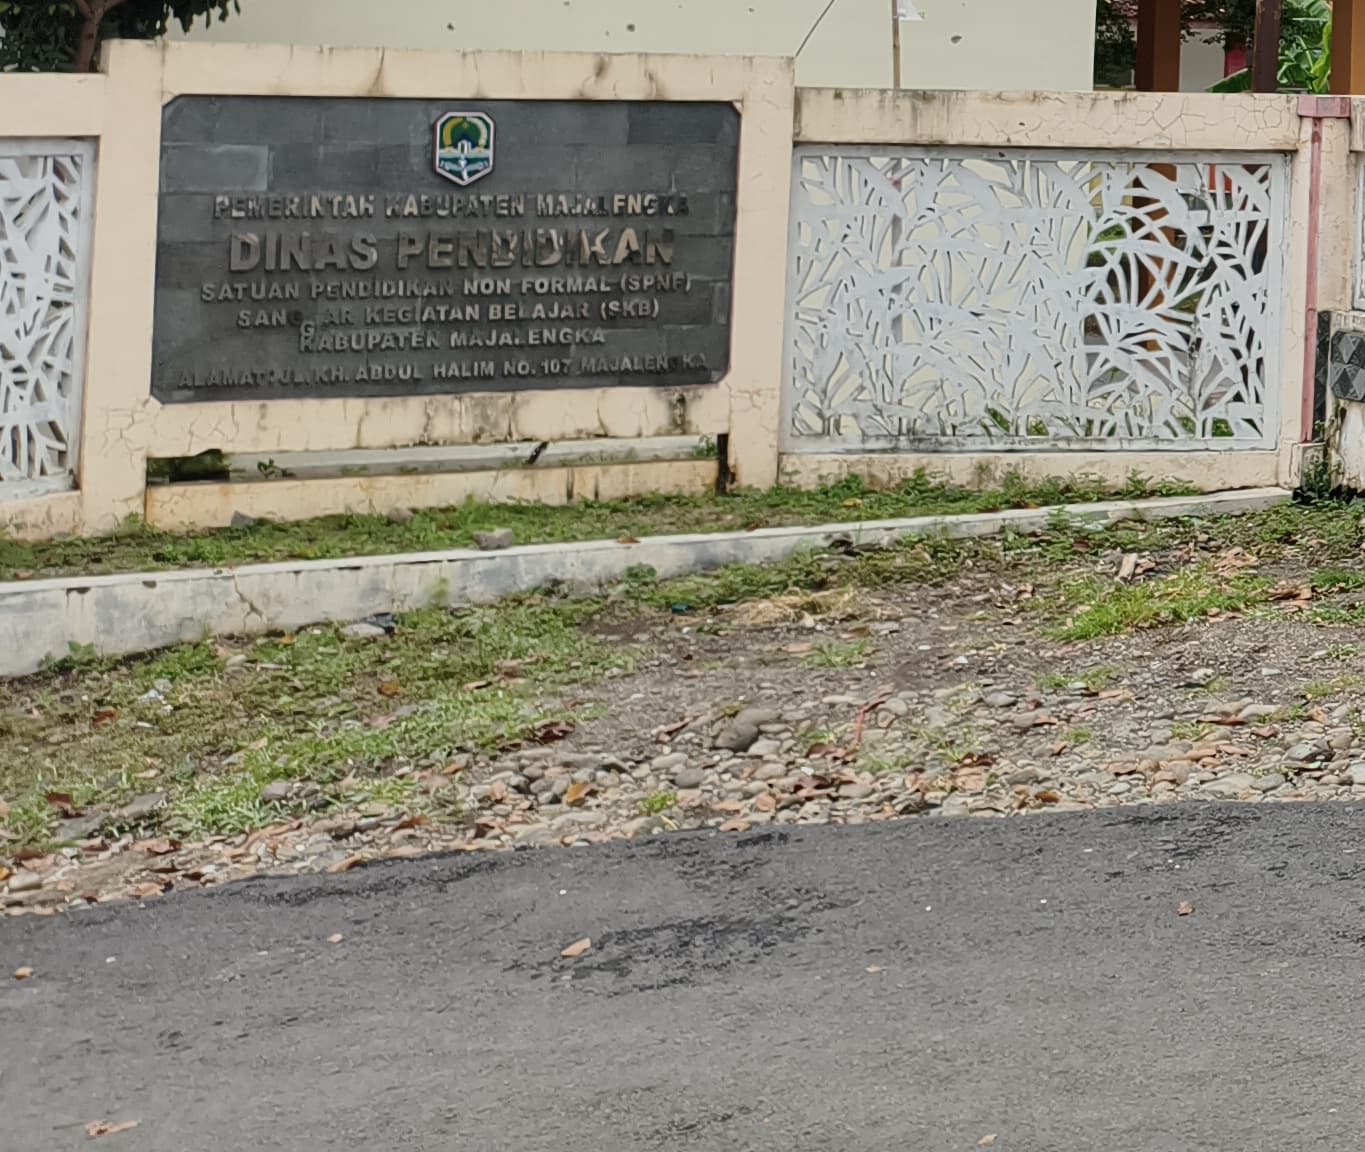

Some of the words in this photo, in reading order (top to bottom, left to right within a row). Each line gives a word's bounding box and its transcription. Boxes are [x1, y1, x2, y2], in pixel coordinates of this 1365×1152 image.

[386, 194, 525, 218] KABUPATEN
[230, 232, 379, 271] DINAS
[398, 227, 673, 269] PENDIDIKAN
[201, 281, 299, 301] SATUAN
[311, 278, 454, 298] PENDIDIKAN
[464, 277, 511, 295] NON
[521, 275, 611, 294] FORMAL
[620, 272, 692, 292] (SPNF)
[365, 303, 480, 324] KEGIATAN
[488, 301, 591, 321] BELAJAR
[601, 298, 660, 320] (SKB)
[300, 331, 441, 352] KABUPATEN
[355, 362, 424, 381] ABDUL
[432, 360, 495, 378] HALIM
[503, 358, 536, 376] NO.
